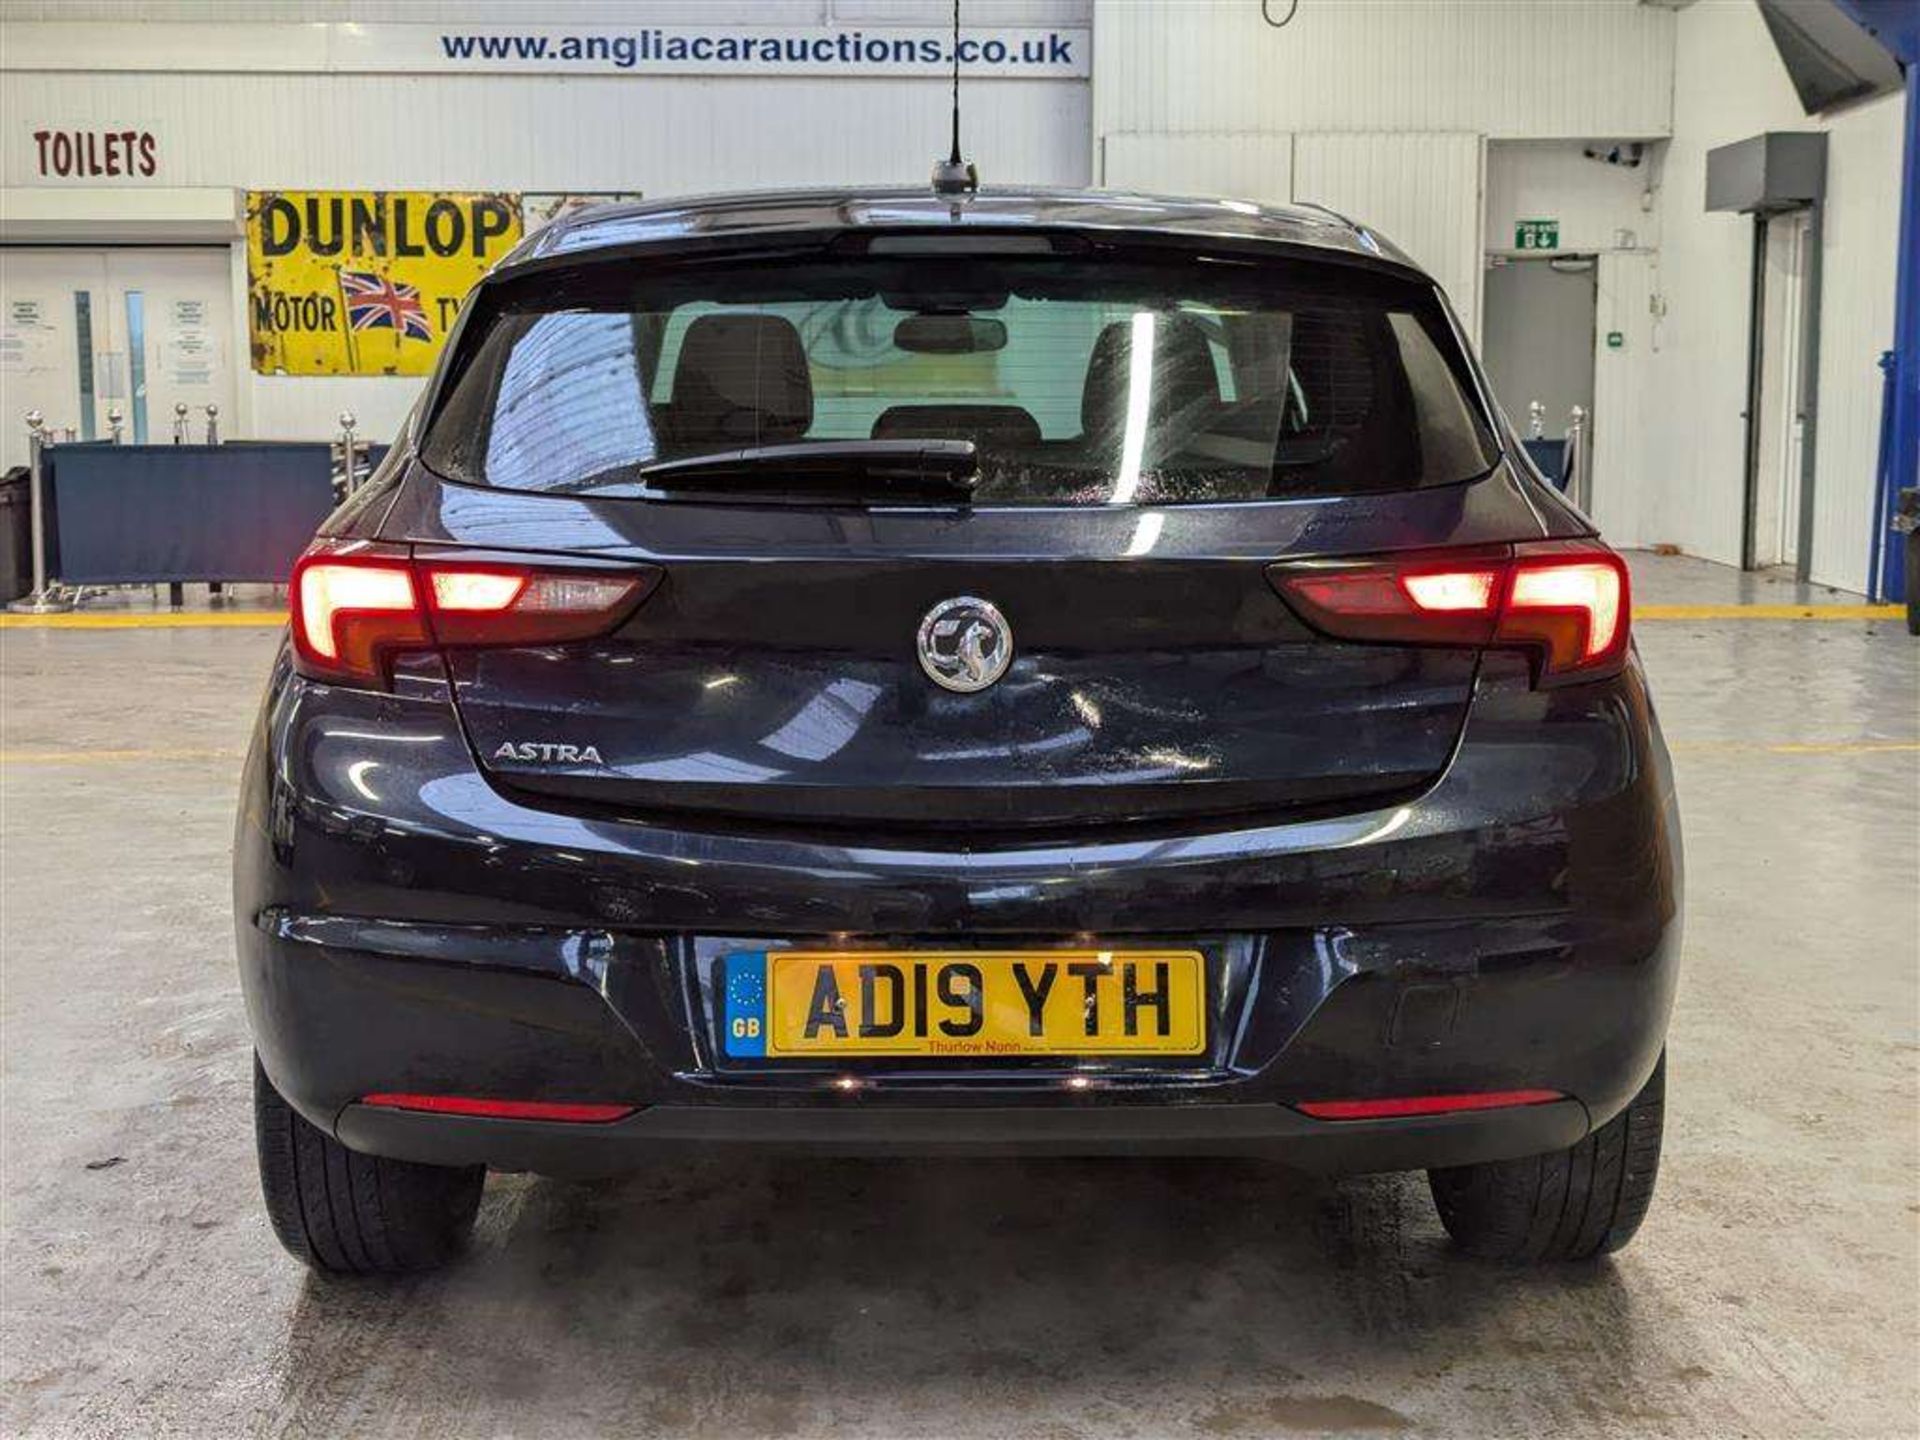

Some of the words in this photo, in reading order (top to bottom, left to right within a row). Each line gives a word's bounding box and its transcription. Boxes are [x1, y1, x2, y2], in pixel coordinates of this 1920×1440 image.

[442, 30, 1072, 68] www.angliacarauctions.co.uk
[33, 131, 156, 177] TOILETS
[261, 198, 511, 258] DUNLOP
[256, 296, 337, 332] MOTOR
[493, 742, 603, 764] ASTRA
[803, 962, 983, 1039] AD19
[1012, 962, 1170, 1037] YTH
[732, 1018, 760, 1038] GB
[928, 1040, 982, 1053] Thurlow
[985, 1040, 1021, 1053] Nunn
